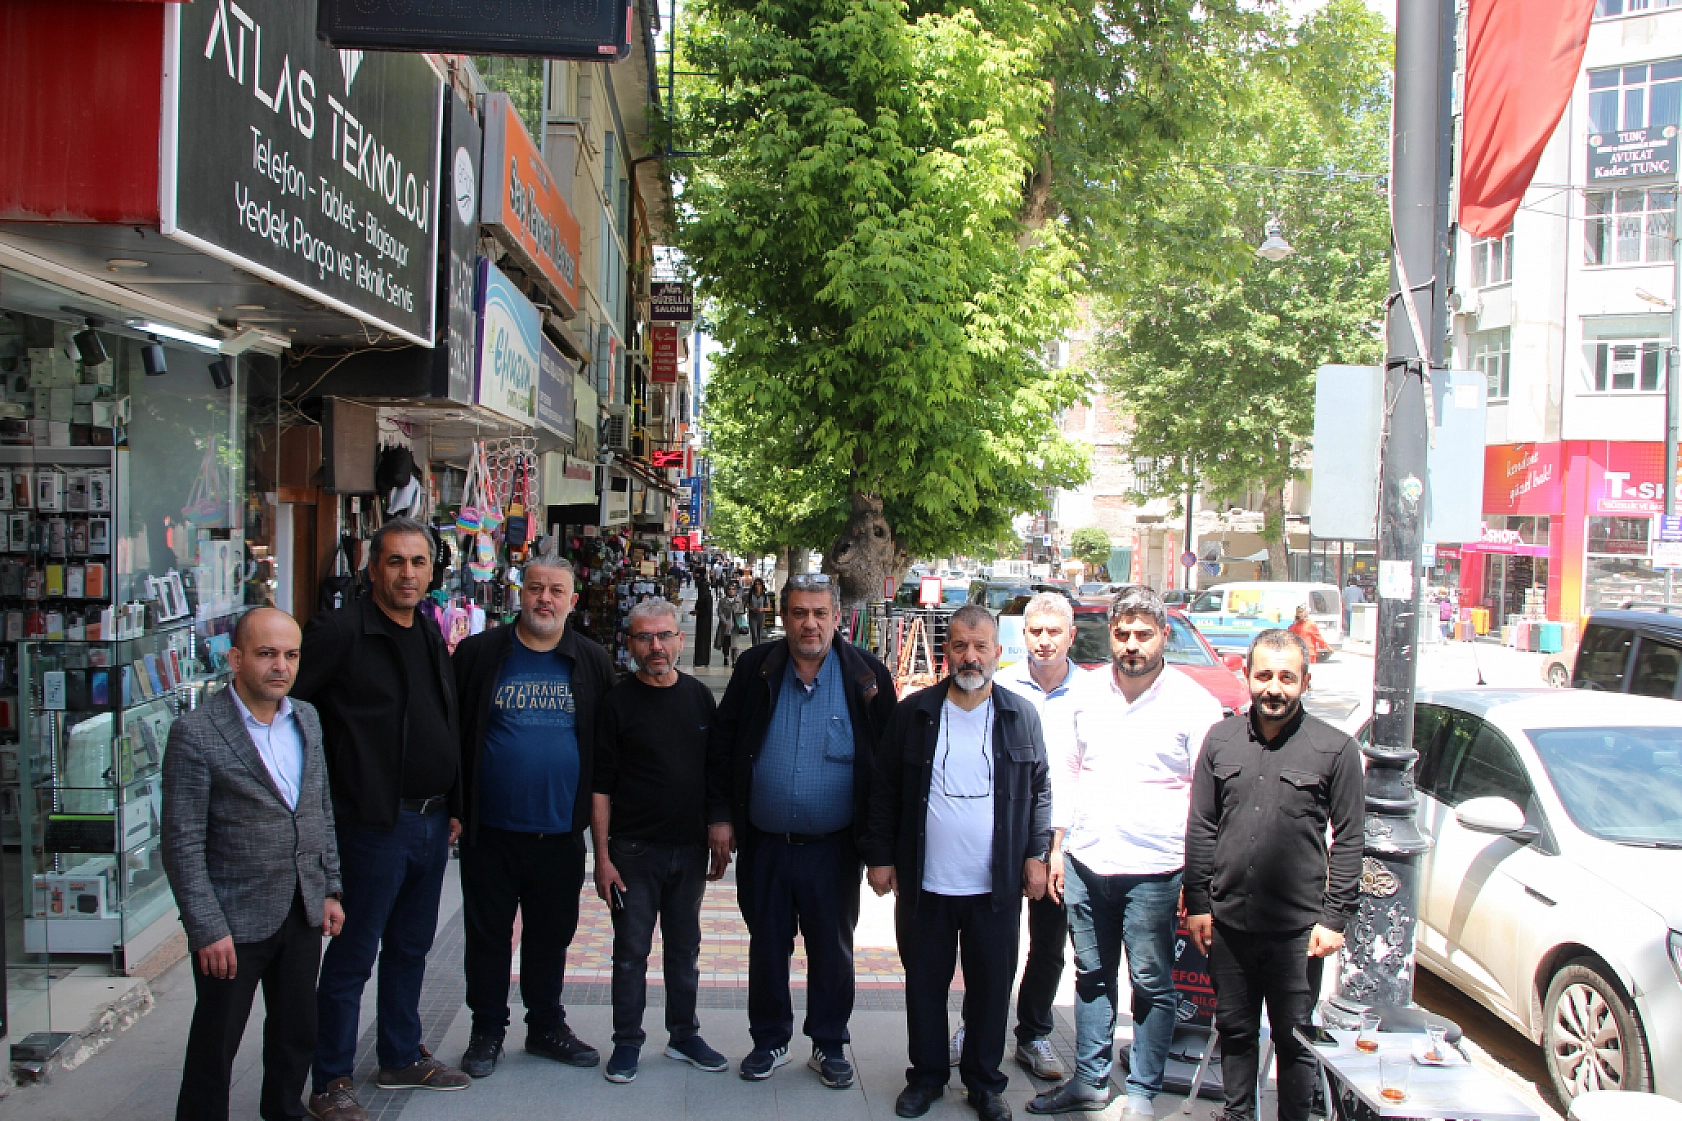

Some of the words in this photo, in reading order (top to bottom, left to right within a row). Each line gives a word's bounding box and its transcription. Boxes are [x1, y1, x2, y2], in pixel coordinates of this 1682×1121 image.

[204, 0, 316, 139] ATLAS
[1609, 148, 1655, 164] AVUKAT
[1594, 164, 1629, 179] Kader
[1630, 159, 1670, 174] TUNÇ
[250, 125, 307, 200] Telefon
[318, 175, 357, 234] Tablet
[365, 210, 409, 268] Bilgisayar
[234, 180, 290, 249] Yedek
[292, 215, 335, 281] Parça
[336, 250, 352, 281] ve
[353, 252, 386, 300] Teknik
[386, 272, 415, 313] Servis
[525, 684, 573, 697] TRAVEL
[1171, 968, 1211, 986] EFON
